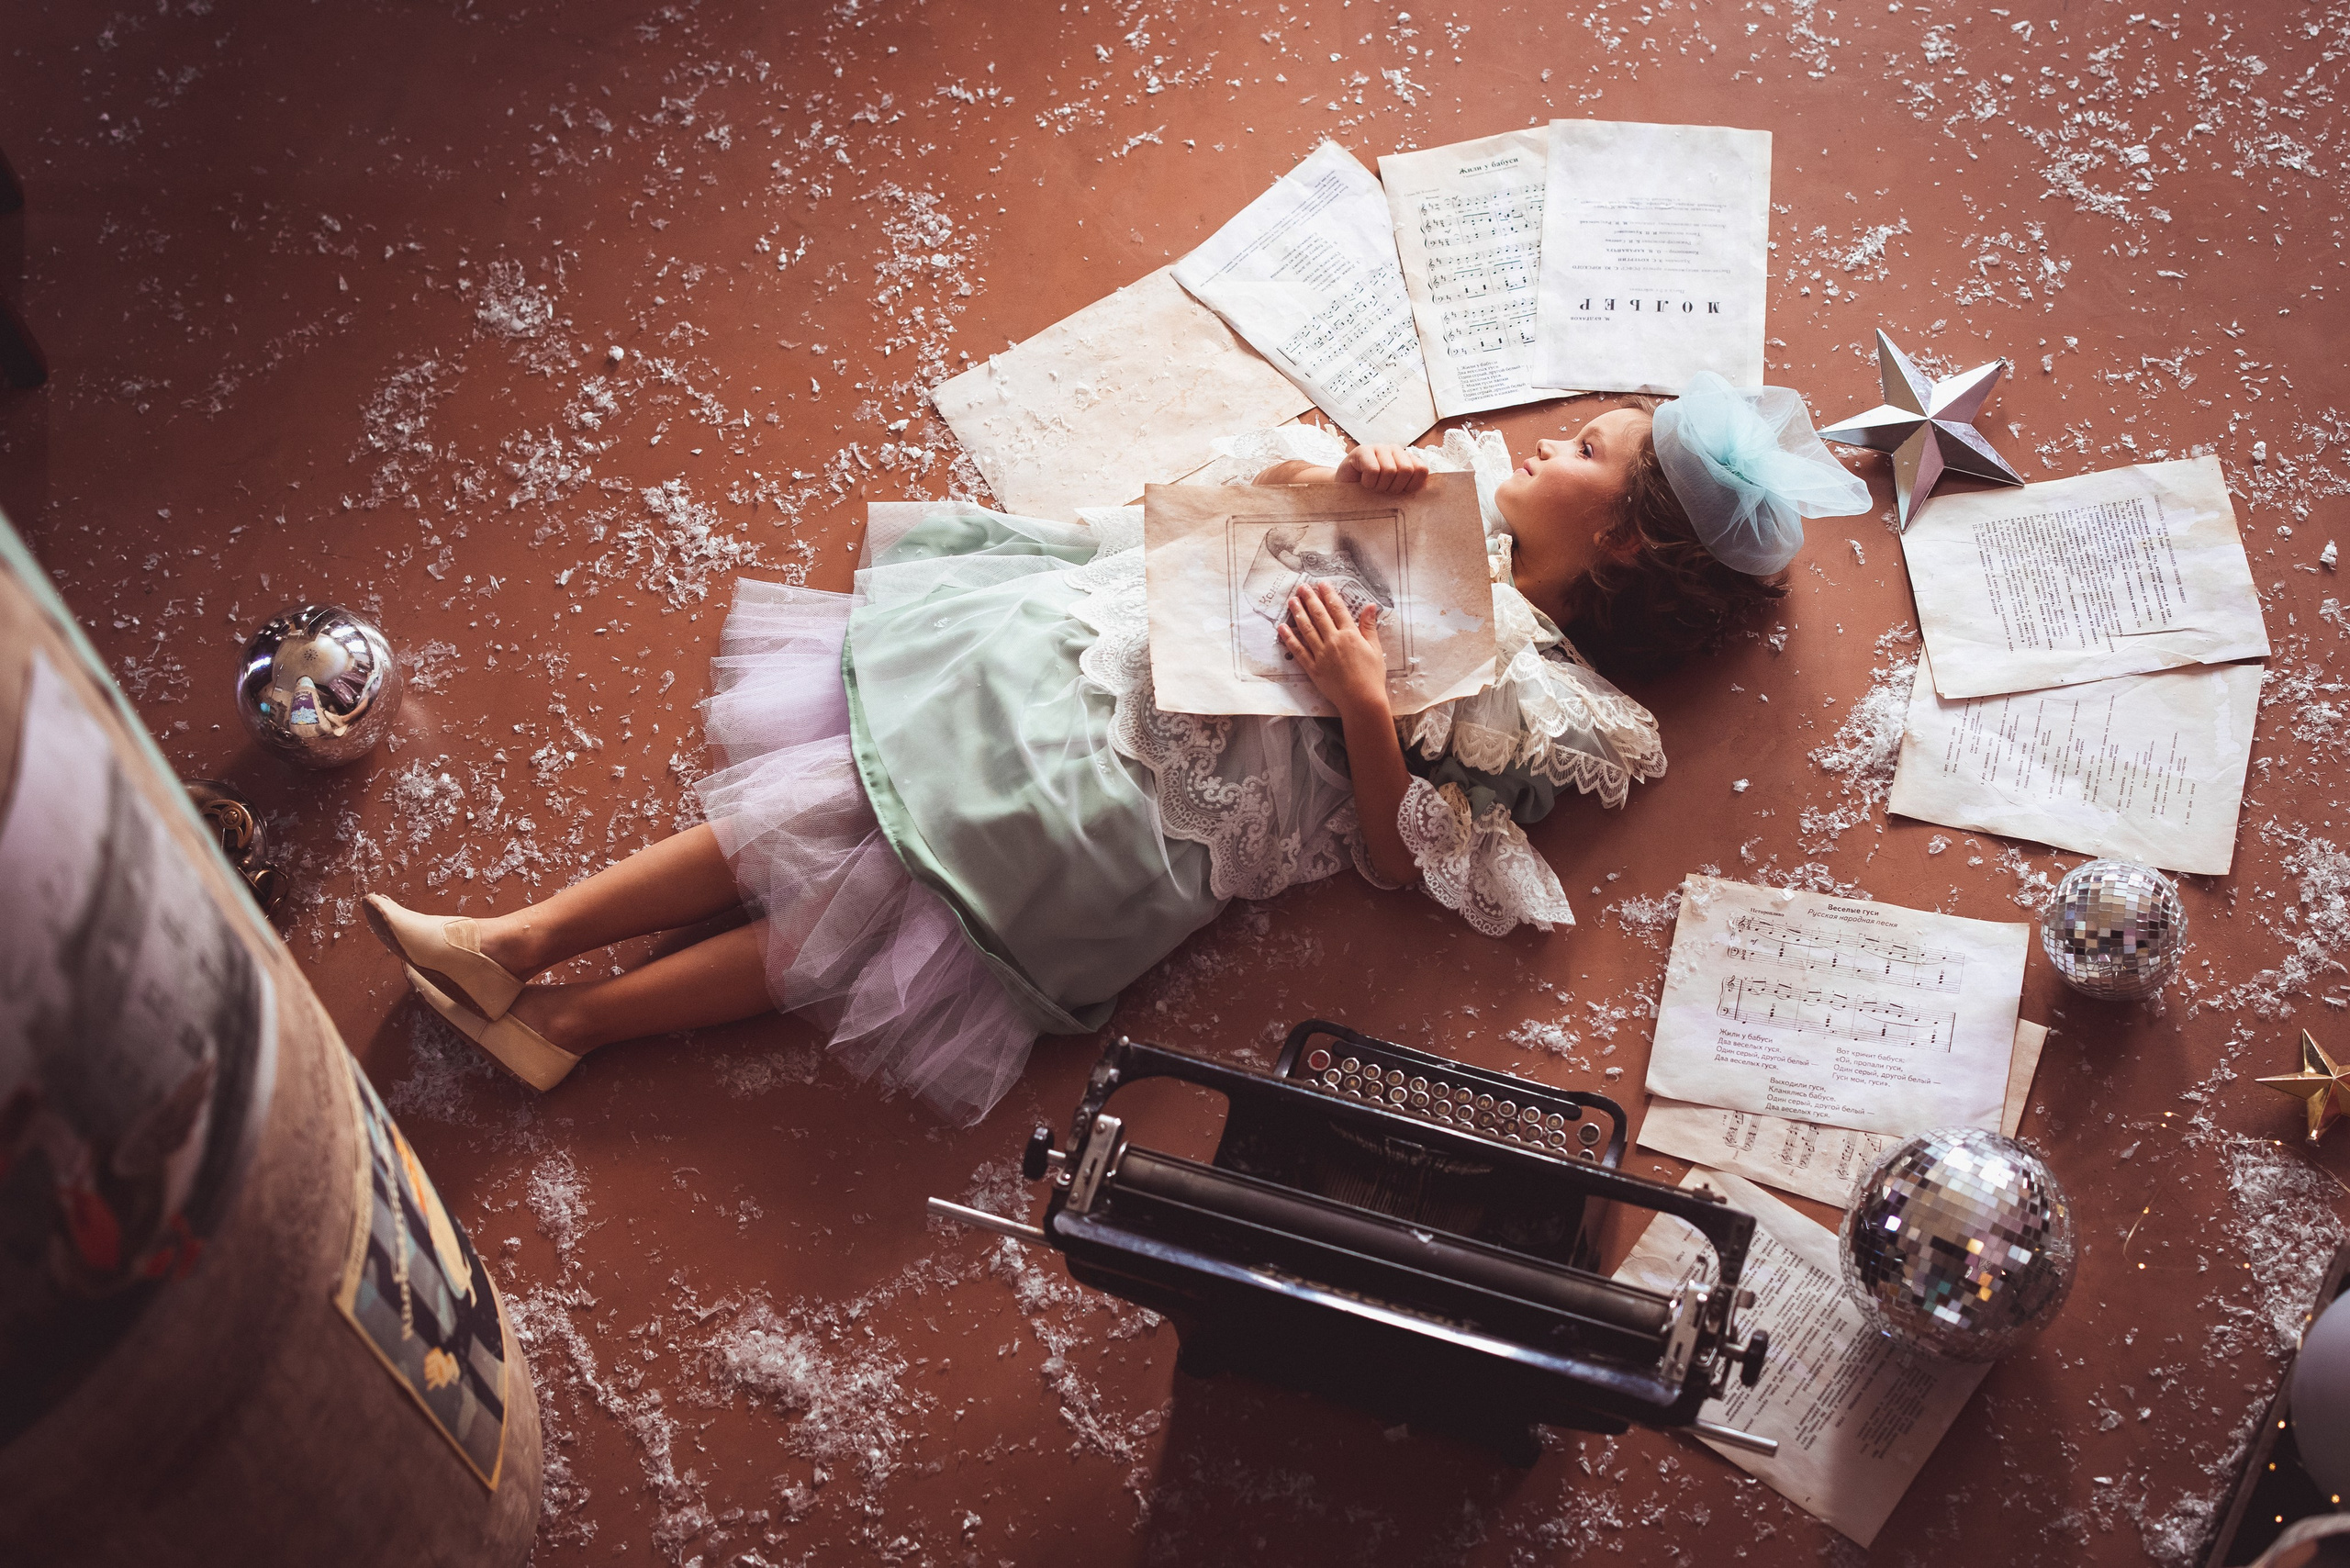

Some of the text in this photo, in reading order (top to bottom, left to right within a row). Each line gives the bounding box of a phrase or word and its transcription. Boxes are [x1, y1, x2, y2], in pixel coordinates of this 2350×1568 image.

[1460, 166, 1482, 174] Жили
[1492, 158, 1518, 167] бабуси
[1751, 908, 1785, 917] Неторопливо
[1807, 909, 1838, 919] Русская
[1828, 904, 1861, 913] Веселые
[1719, 1028, 1740, 1037] Жили
[1748, 1034, 1773, 1043] бабуси
[1718, 1037, 1731, 1046] Два
[1733, 1041, 1762, 1050] веселых
[1714, 1054, 1729, 1062] Два
[1730, 1058, 1760, 1067] веселых
[1716, 1046, 1809, 1066] Один серый, другой белый
[1835, 1056, 1852, 1065] «Ой,
[1853, 1060, 1884, 1069] пропали
[1832, 1072, 1849, 1081] Гуси
[1833, 1064, 1852, 1072] Один
[1854, 1069, 1879, 1077] серый,
[1908, 1075, 1930, 1084] белый
[1770, 1077, 1826, 1092] Выходили гуси,
[1769, 1086, 1836, 1102] Кланялись бабусе.
[1765, 1103, 1780, 1112] Два
[1781, 1106, 1811, 1114] веселых
[1767, 1093, 1786, 1103] Один
[1787, 1099, 1812, 1107] серый,
[1841, 1105, 1864, 1114] белый
